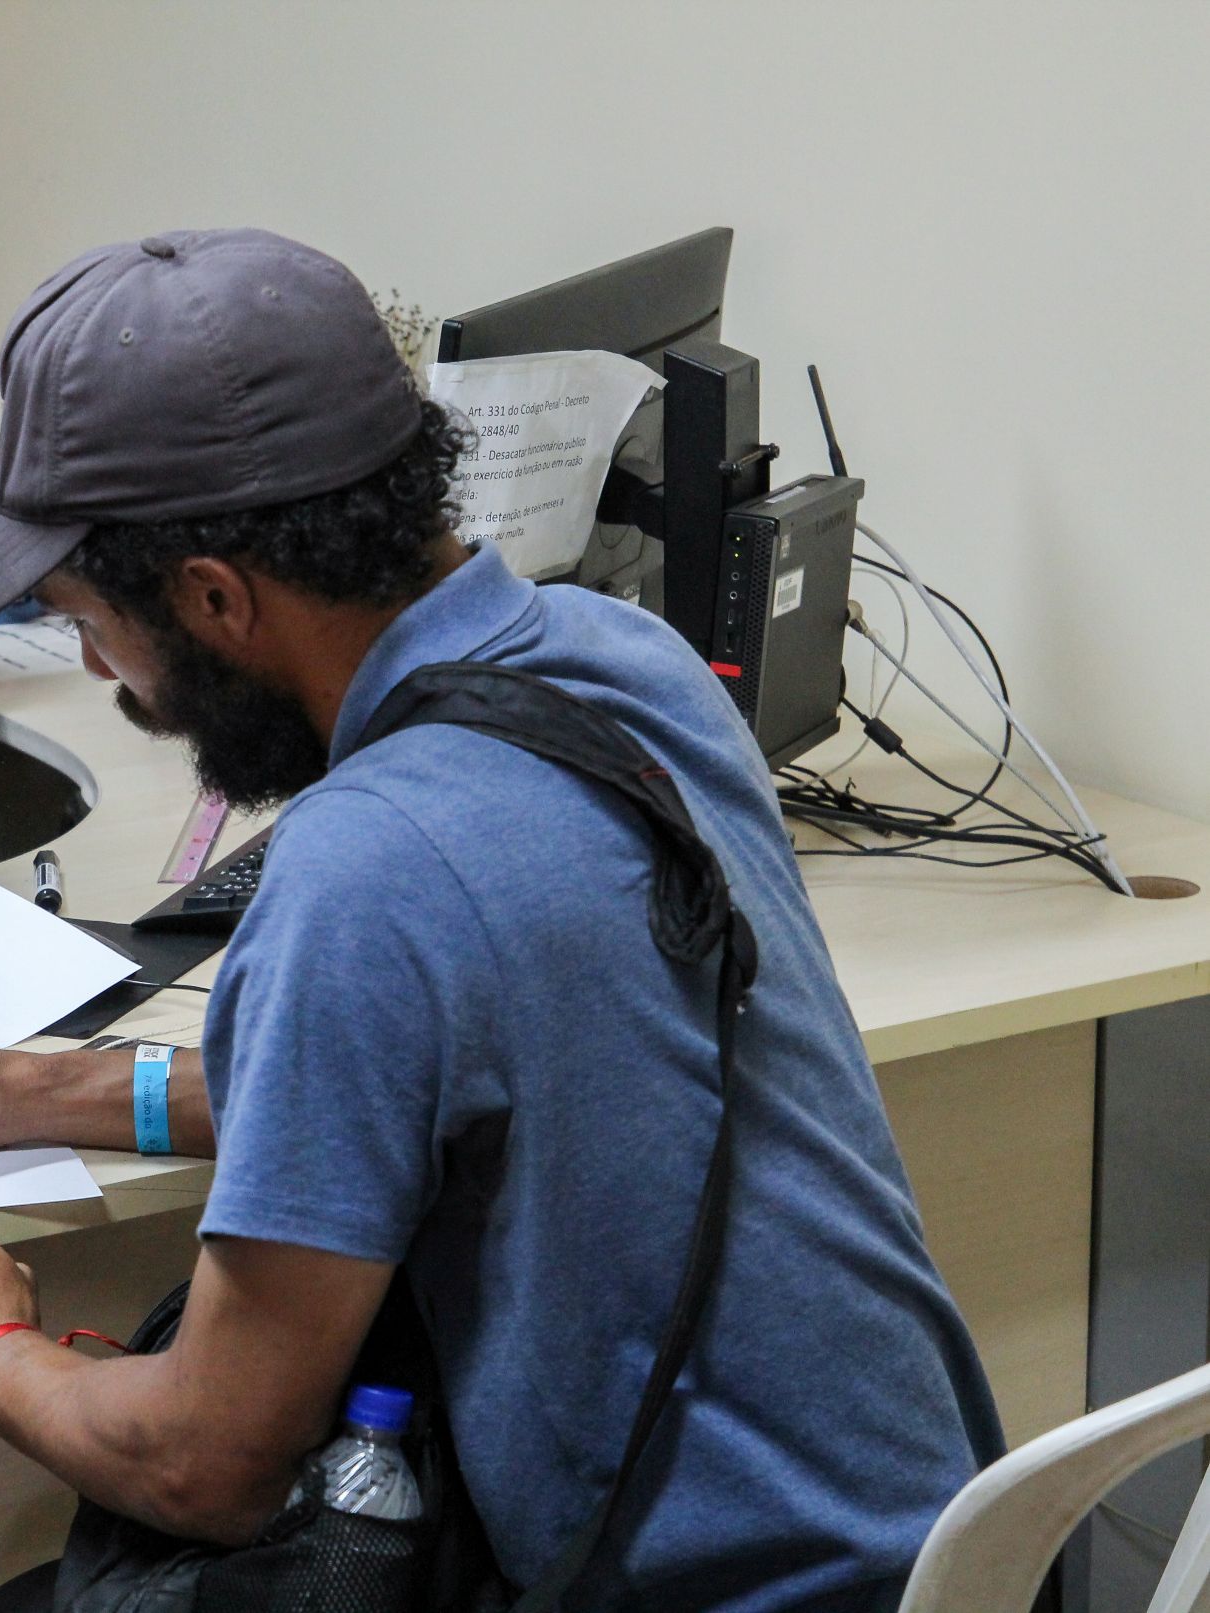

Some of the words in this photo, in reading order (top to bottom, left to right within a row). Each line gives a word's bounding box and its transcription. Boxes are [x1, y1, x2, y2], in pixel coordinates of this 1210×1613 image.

[468, 406, 484, 417] Art.
[487, 406, 505, 417] 331
[508, 405, 519, 416] do
[521, 401, 543, 415] Código
[544, 398, 560, 410] Penal
[565, 395, 590, 407] Decreto
[481, 424, 519, 438] 2848/40
[489, 449, 526, 461] Desacatar
[526, 441, 564, 455] funcionário
[474, 468, 514, 481] exercício
[514, 468, 522, 478] da
[522, 461, 542, 476] função
[542, 462, 550, 470] ou
[552, 460, 563, 469] em
[565, 456, 583, 466] razão
[460, 514, 476, 523] ena
[523, 507, 530, 516] de
[495, 532, 504, 541] ou
[142, 1085, 151, 1115] edição
[144, 1117, 152, 1129] do
